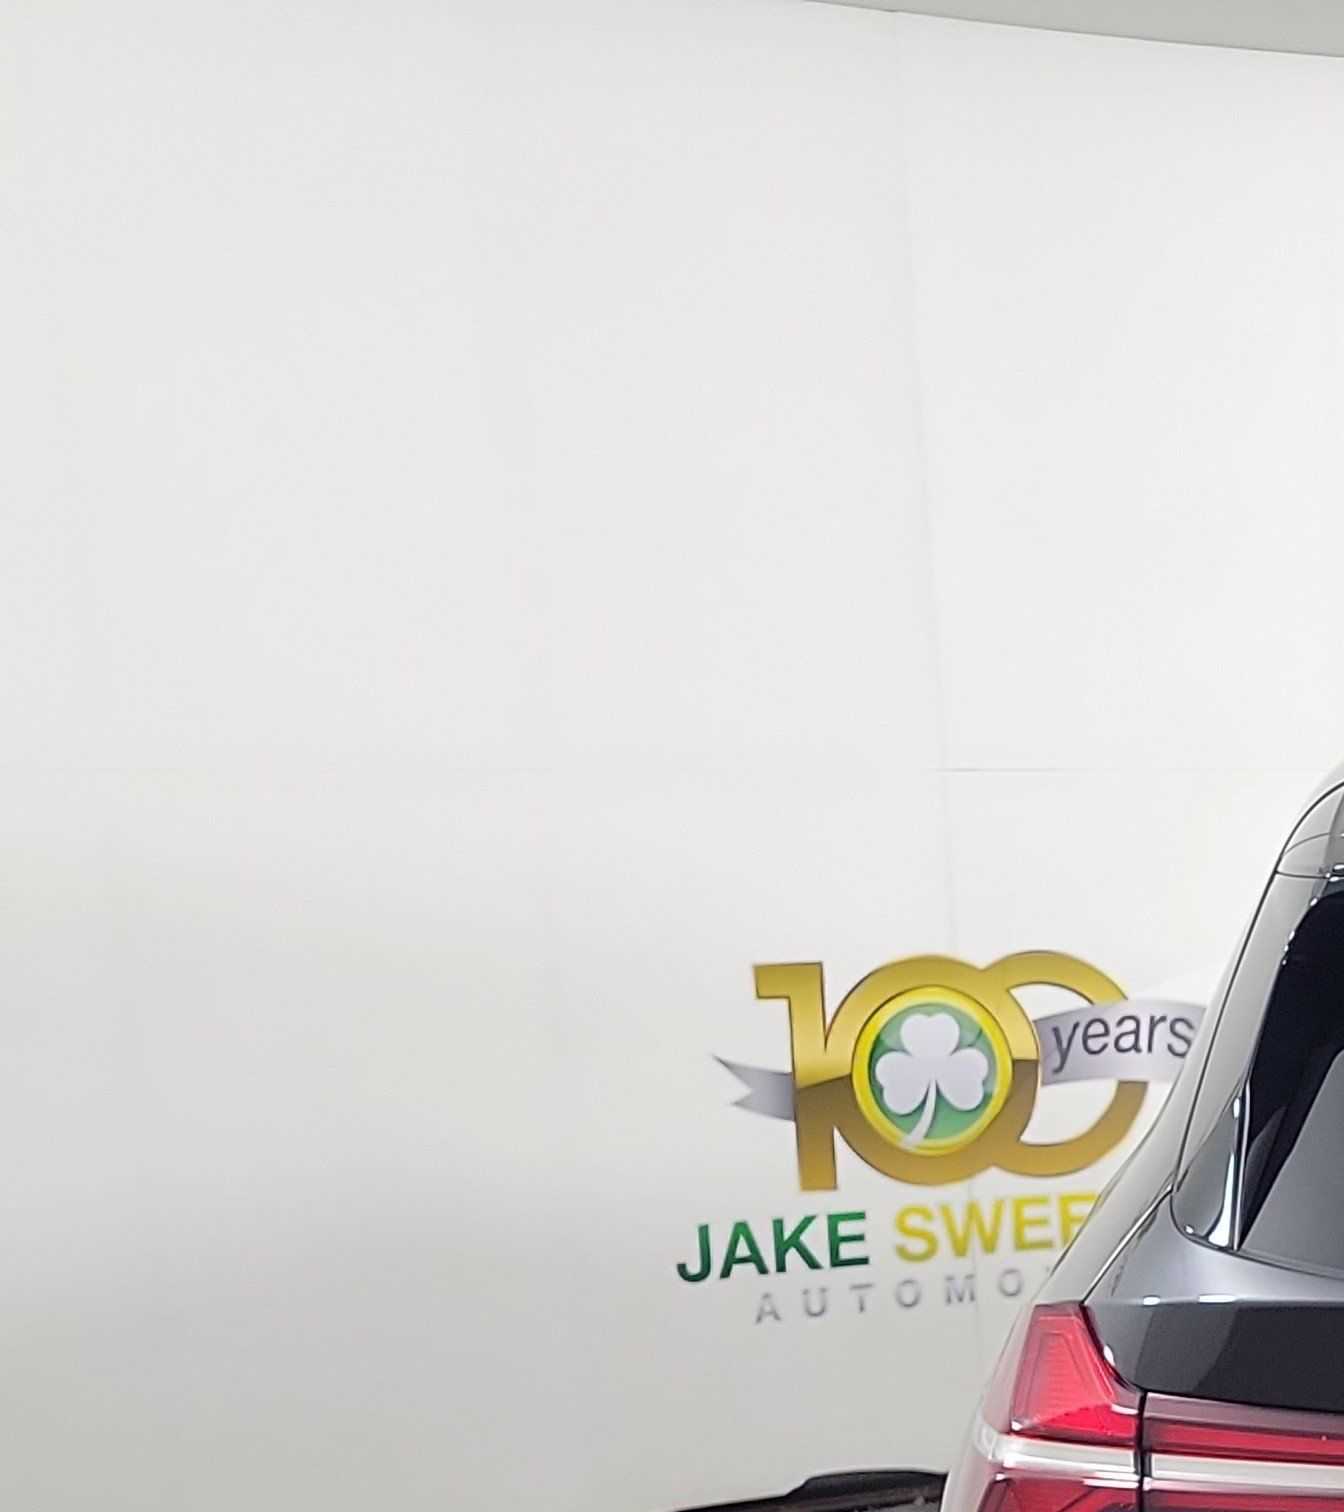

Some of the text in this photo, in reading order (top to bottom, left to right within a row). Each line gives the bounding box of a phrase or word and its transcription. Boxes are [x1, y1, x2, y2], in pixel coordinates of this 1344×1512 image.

[1052, 1014, 1195, 1074] years
[676, 1191, 1098, 1284] JAKE SWEE
[754, 1267, 1022, 1325] AUTOMO
